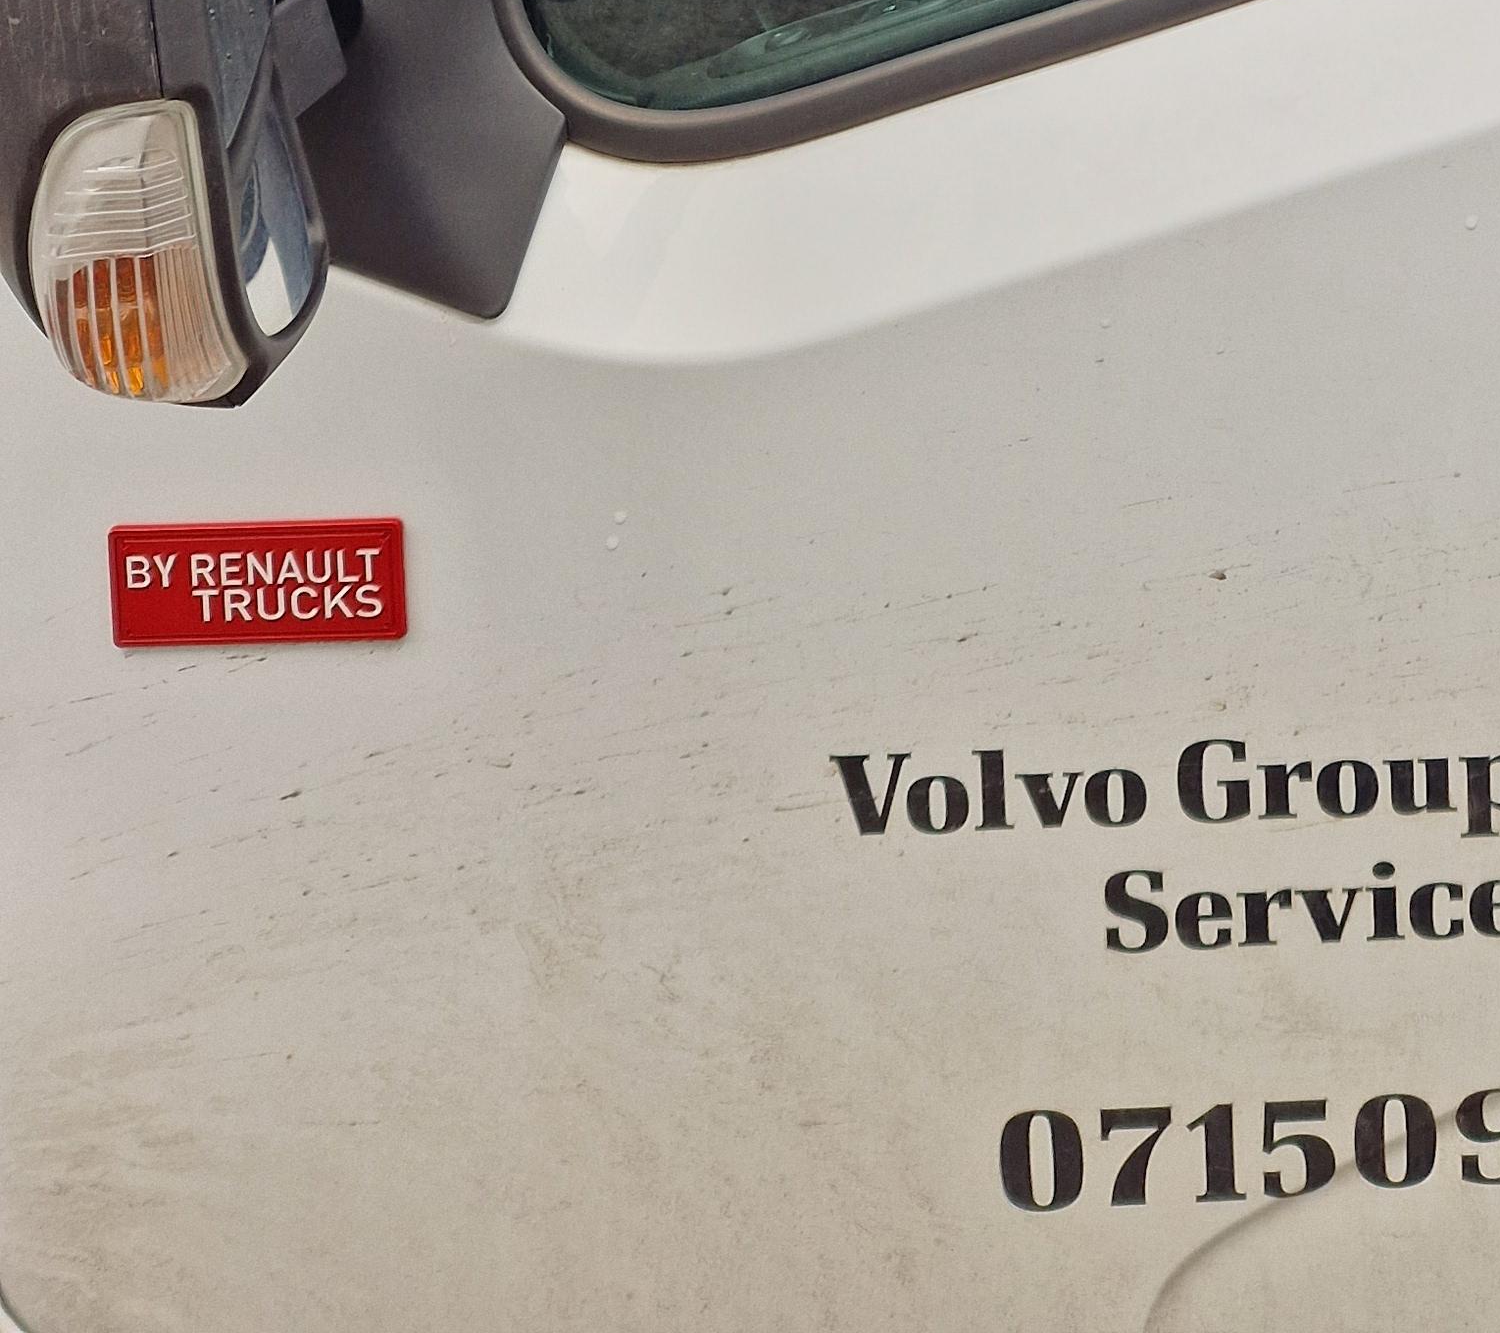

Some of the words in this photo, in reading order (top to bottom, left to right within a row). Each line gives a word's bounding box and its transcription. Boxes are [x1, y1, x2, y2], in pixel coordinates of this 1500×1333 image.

[125, 553, 178, 589] BY
[190, 548, 382, 587] RENAULT
[192, 584, 384, 622] TRUCKS
[830, 750, 1147, 835] Volvo
